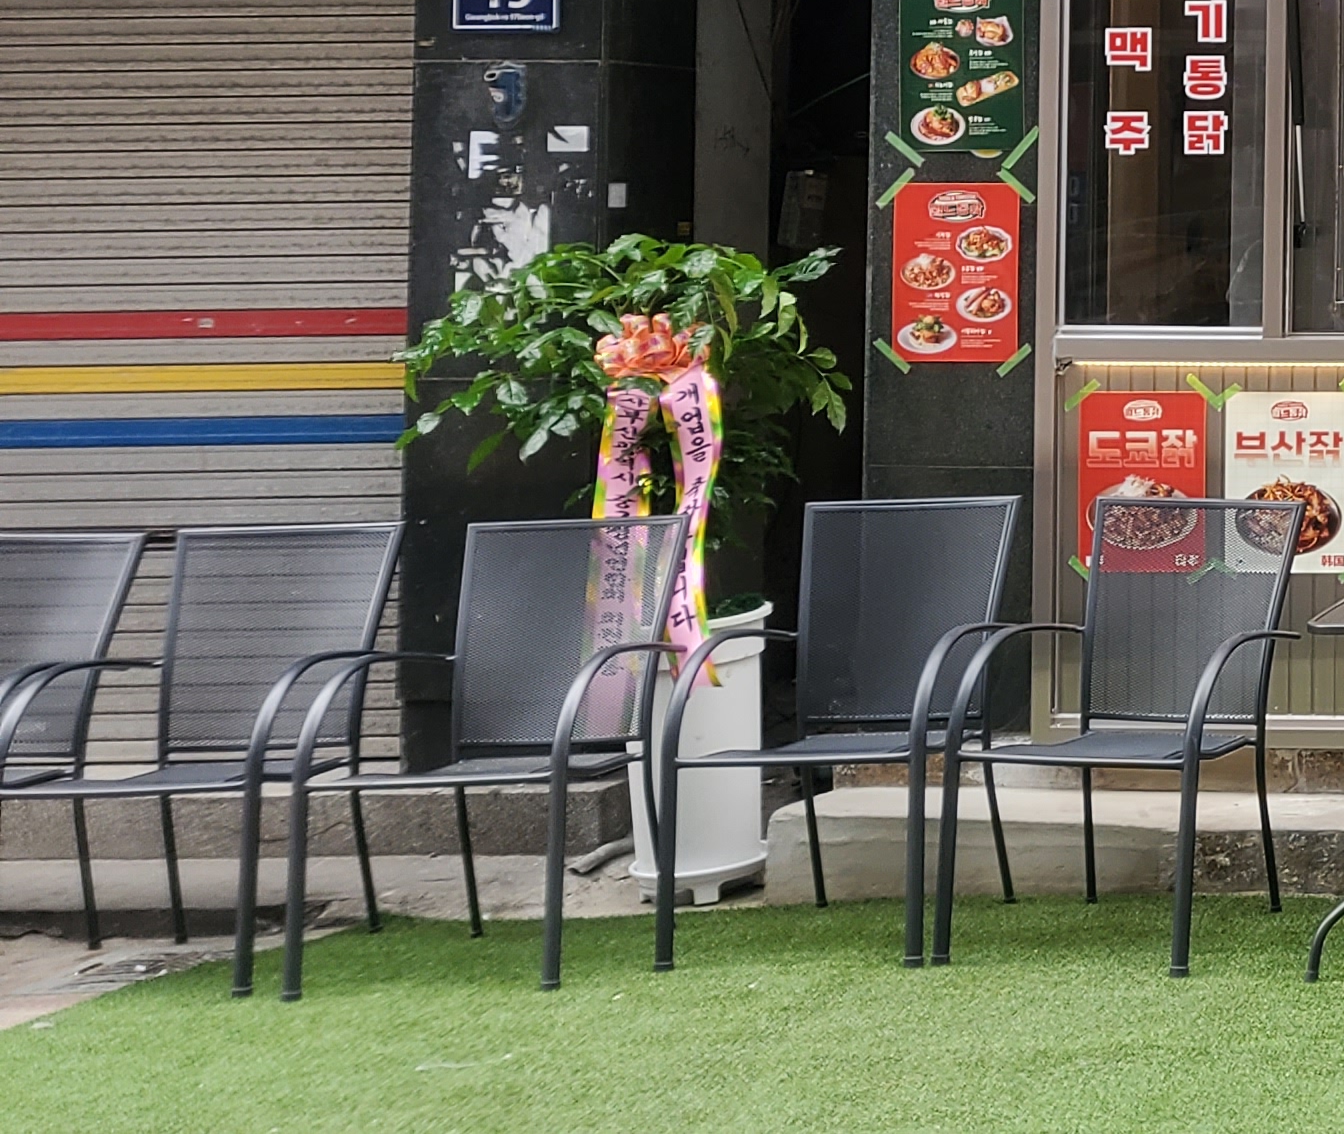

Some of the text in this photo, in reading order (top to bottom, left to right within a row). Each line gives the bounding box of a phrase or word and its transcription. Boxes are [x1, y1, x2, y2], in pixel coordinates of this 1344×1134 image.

[1086, 429, 1199, 469] 도쿄잙
[1234, 431, 1344, 468] 부산잙
[1321, 554, 1344, 567] 韩国
